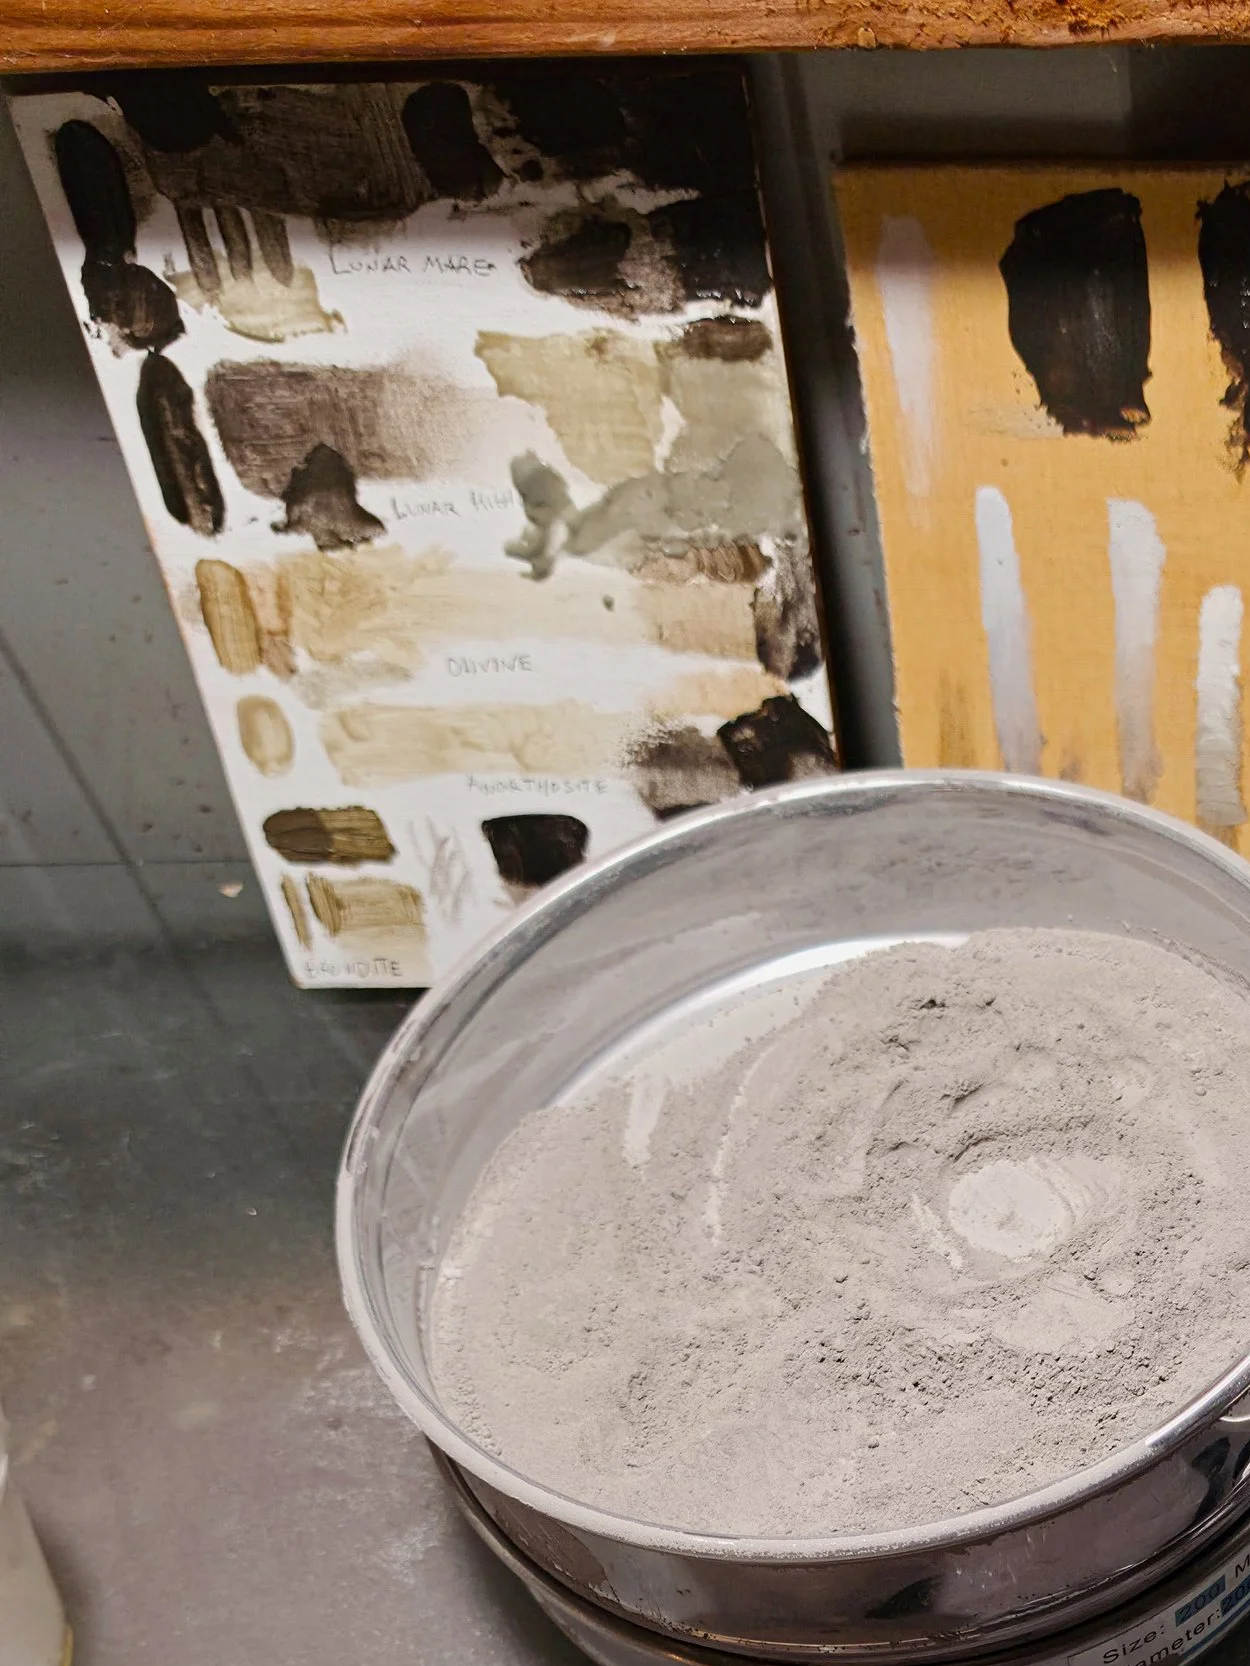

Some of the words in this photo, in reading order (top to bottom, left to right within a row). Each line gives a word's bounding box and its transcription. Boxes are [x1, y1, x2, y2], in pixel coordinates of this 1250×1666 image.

[329, 246, 411, 275] LUNAR
[389, 494, 462, 521] LUNAR
[446, 654, 533, 677] OLIVINE
[1102, 1624, 1165, 1666] Size:
